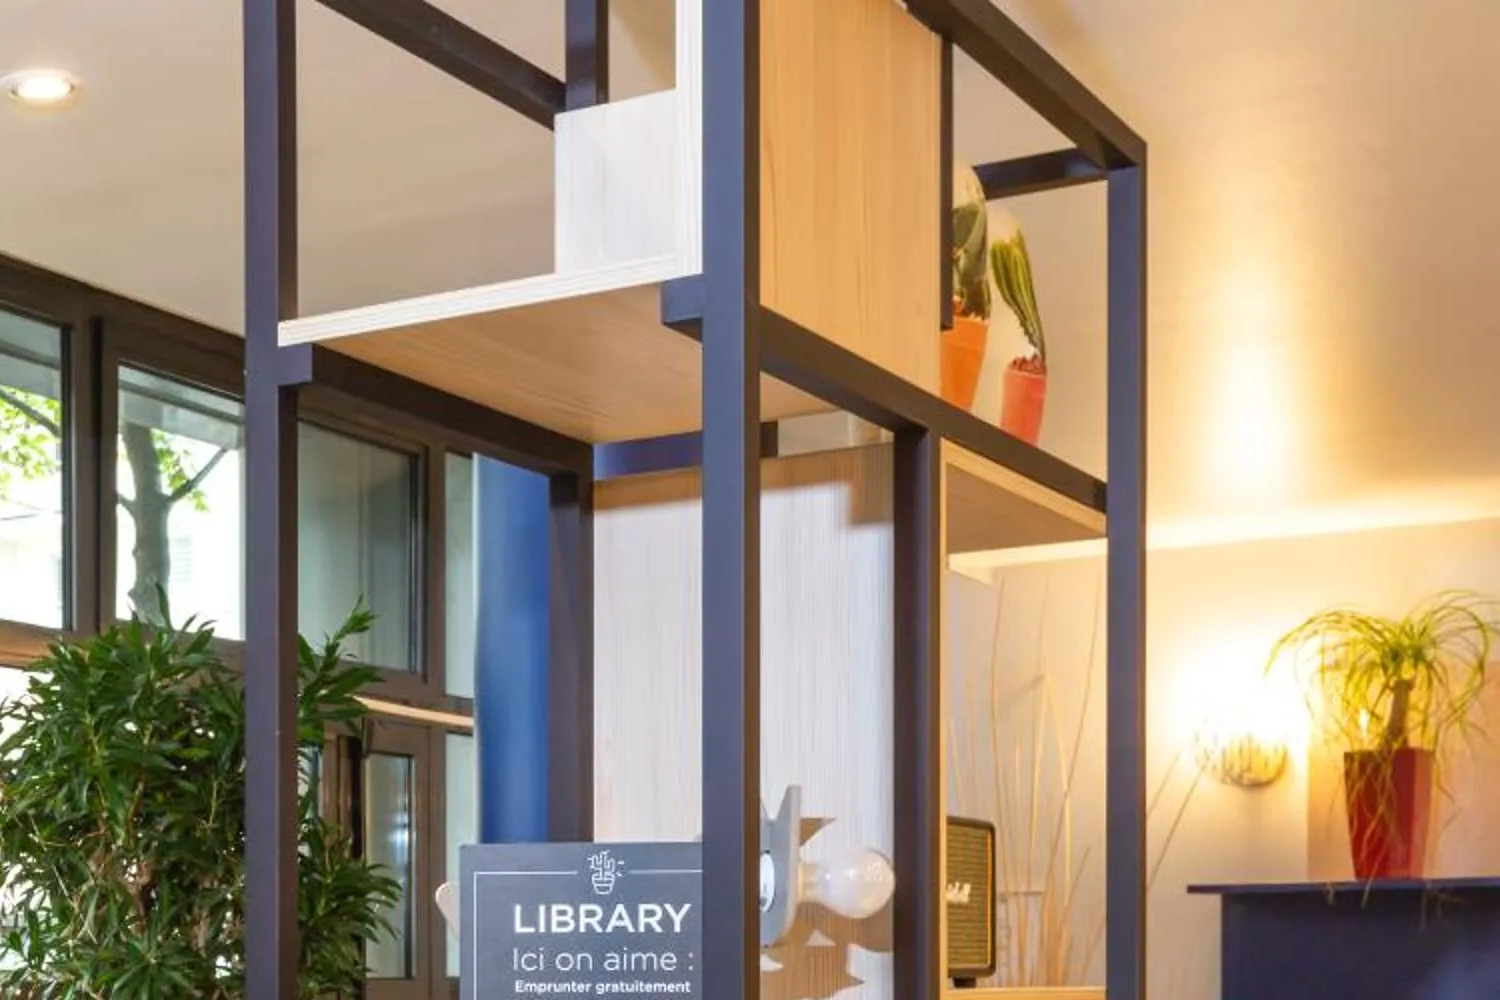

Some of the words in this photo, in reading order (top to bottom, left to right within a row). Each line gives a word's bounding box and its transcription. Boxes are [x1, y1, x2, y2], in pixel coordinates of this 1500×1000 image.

[514, 904, 691, 933] LIBRARY
[513, 948, 545, 971] Ici
[555, 953, 593, 971] on
[603, 947, 677, 971] aime
[515, 980, 591, 994] Emprunter
[595, 980, 691, 994] gratuitement
